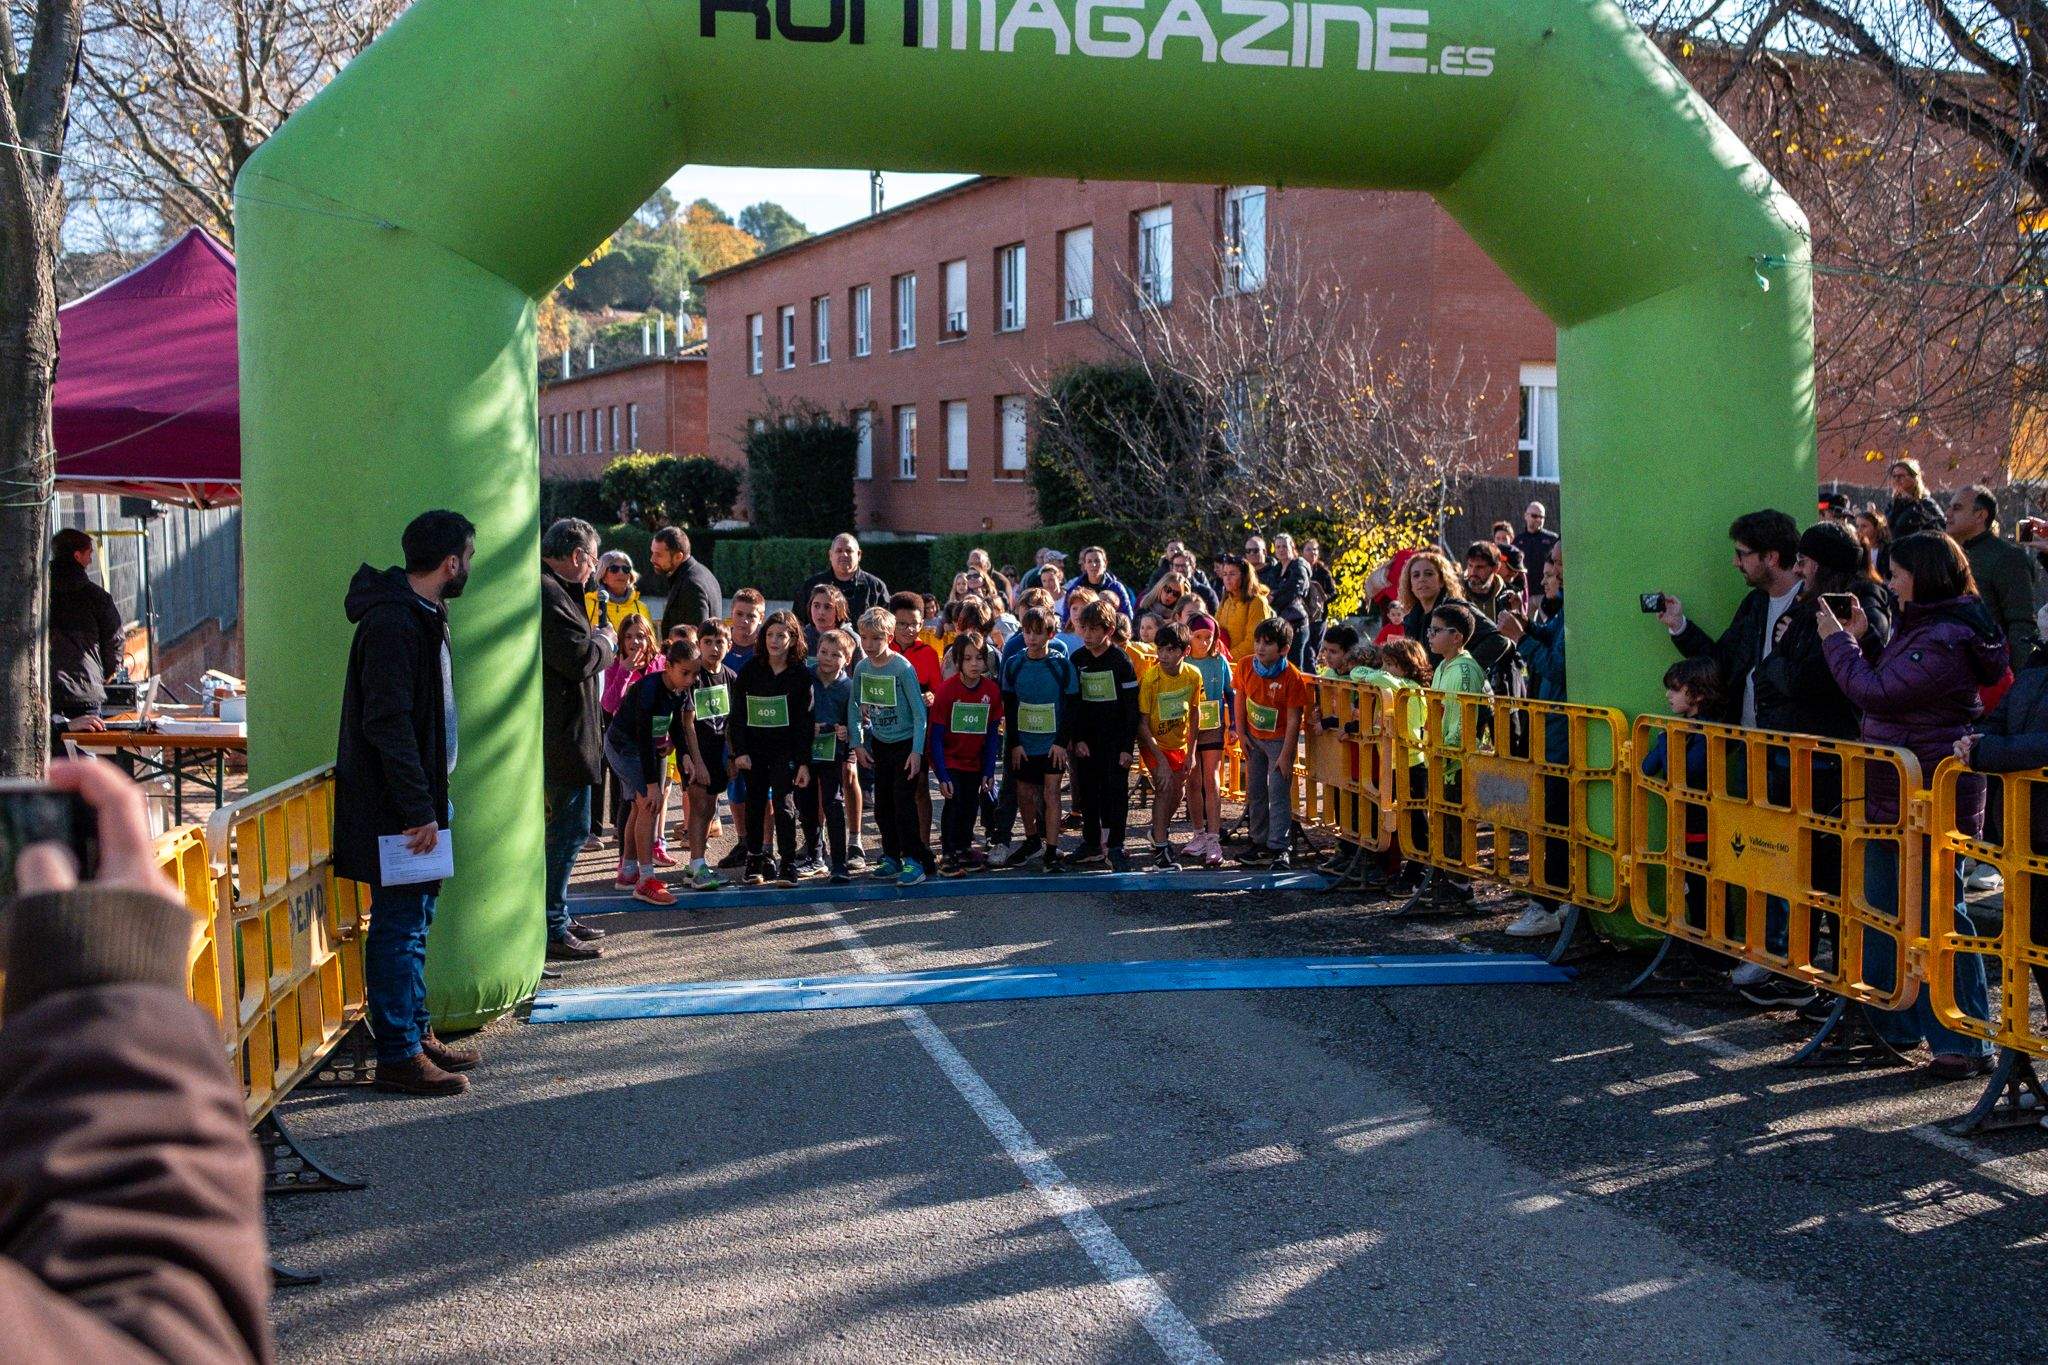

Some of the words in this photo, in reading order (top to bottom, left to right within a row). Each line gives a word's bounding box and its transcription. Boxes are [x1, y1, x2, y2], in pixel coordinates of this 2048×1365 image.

[869, 687, 885, 696] 416
[757, 708, 776, 717] 409
[962, 715, 979, 723] 404
